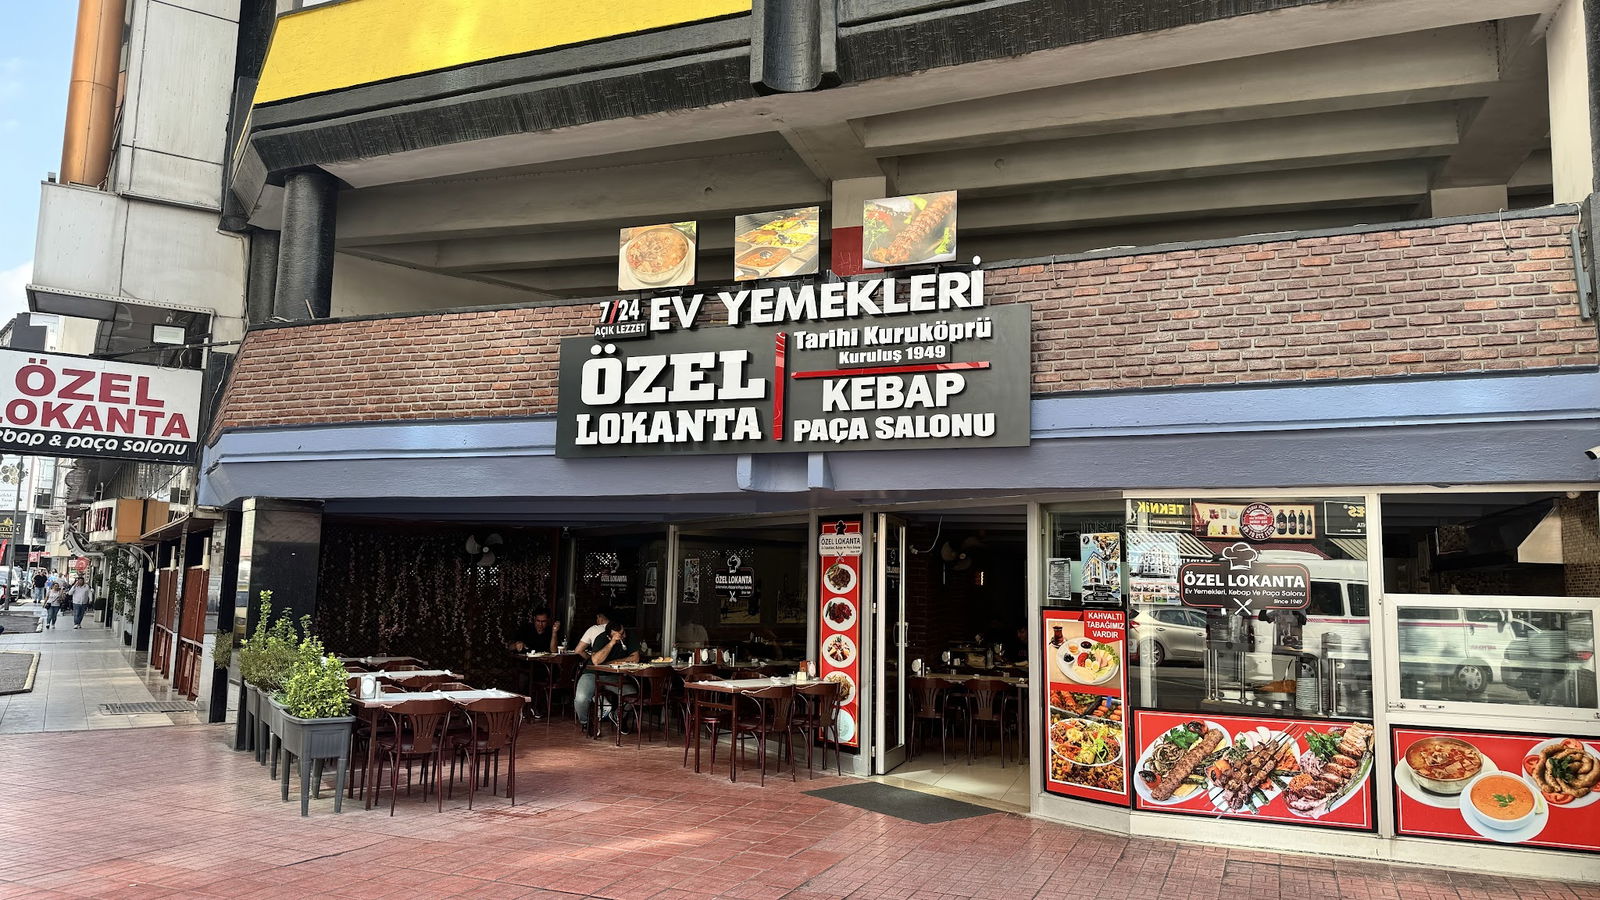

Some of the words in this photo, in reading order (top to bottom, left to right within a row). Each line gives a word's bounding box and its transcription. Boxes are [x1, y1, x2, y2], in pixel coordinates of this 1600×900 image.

[650, 294, 704, 331] EV
[717, 255, 984, 326] YEMEKLERİ
[600, 298, 640, 325] 7/24
[594, 326, 615, 338] AÇIK
[617, 323, 646, 335] LEZZET
[794, 328, 858, 350] Tarihi
[864, 316, 992, 345] Kuruköprü
[838, 348, 902, 364] Kuruluş
[906, 345, 946, 360] 1949
[15, 357, 165, 408] ÖZEL
[581, 343, 766, 406] ÖZEL
[822, 372, 966, 411] KEBAP
[0, 398, 191, 439] OKANTA
[575, 407, 762, 445] LOKANTA
[794, 417, 869, 443] PAÇA
[875, 413, 996, 440] SALONU
[49, 434, 62, 447] &
[66, 435, 119, 452] paça
[122, 438, 188, 456] salonu
[820, 536, 834, 545] ÖZEL
[835, 537, 861, 545] LOKANTA
[715, 574, 728, 584] ÖZEL
[728, 575, 753, 584] LOKANTA
[1184, 570, 1225, 587] ÖZEL
[1228, 574, 1306, 588] LOKANTA
[1228, 589, 1252, 597] Kebap
[1262, 590, 1281, 598] Paça
[1087, 620, 1125, 630] TABAĞIMIZ
[1088, 612, 1123, 621] KAHVALTI
[1092, 630, 1119, 638] VARDIR
